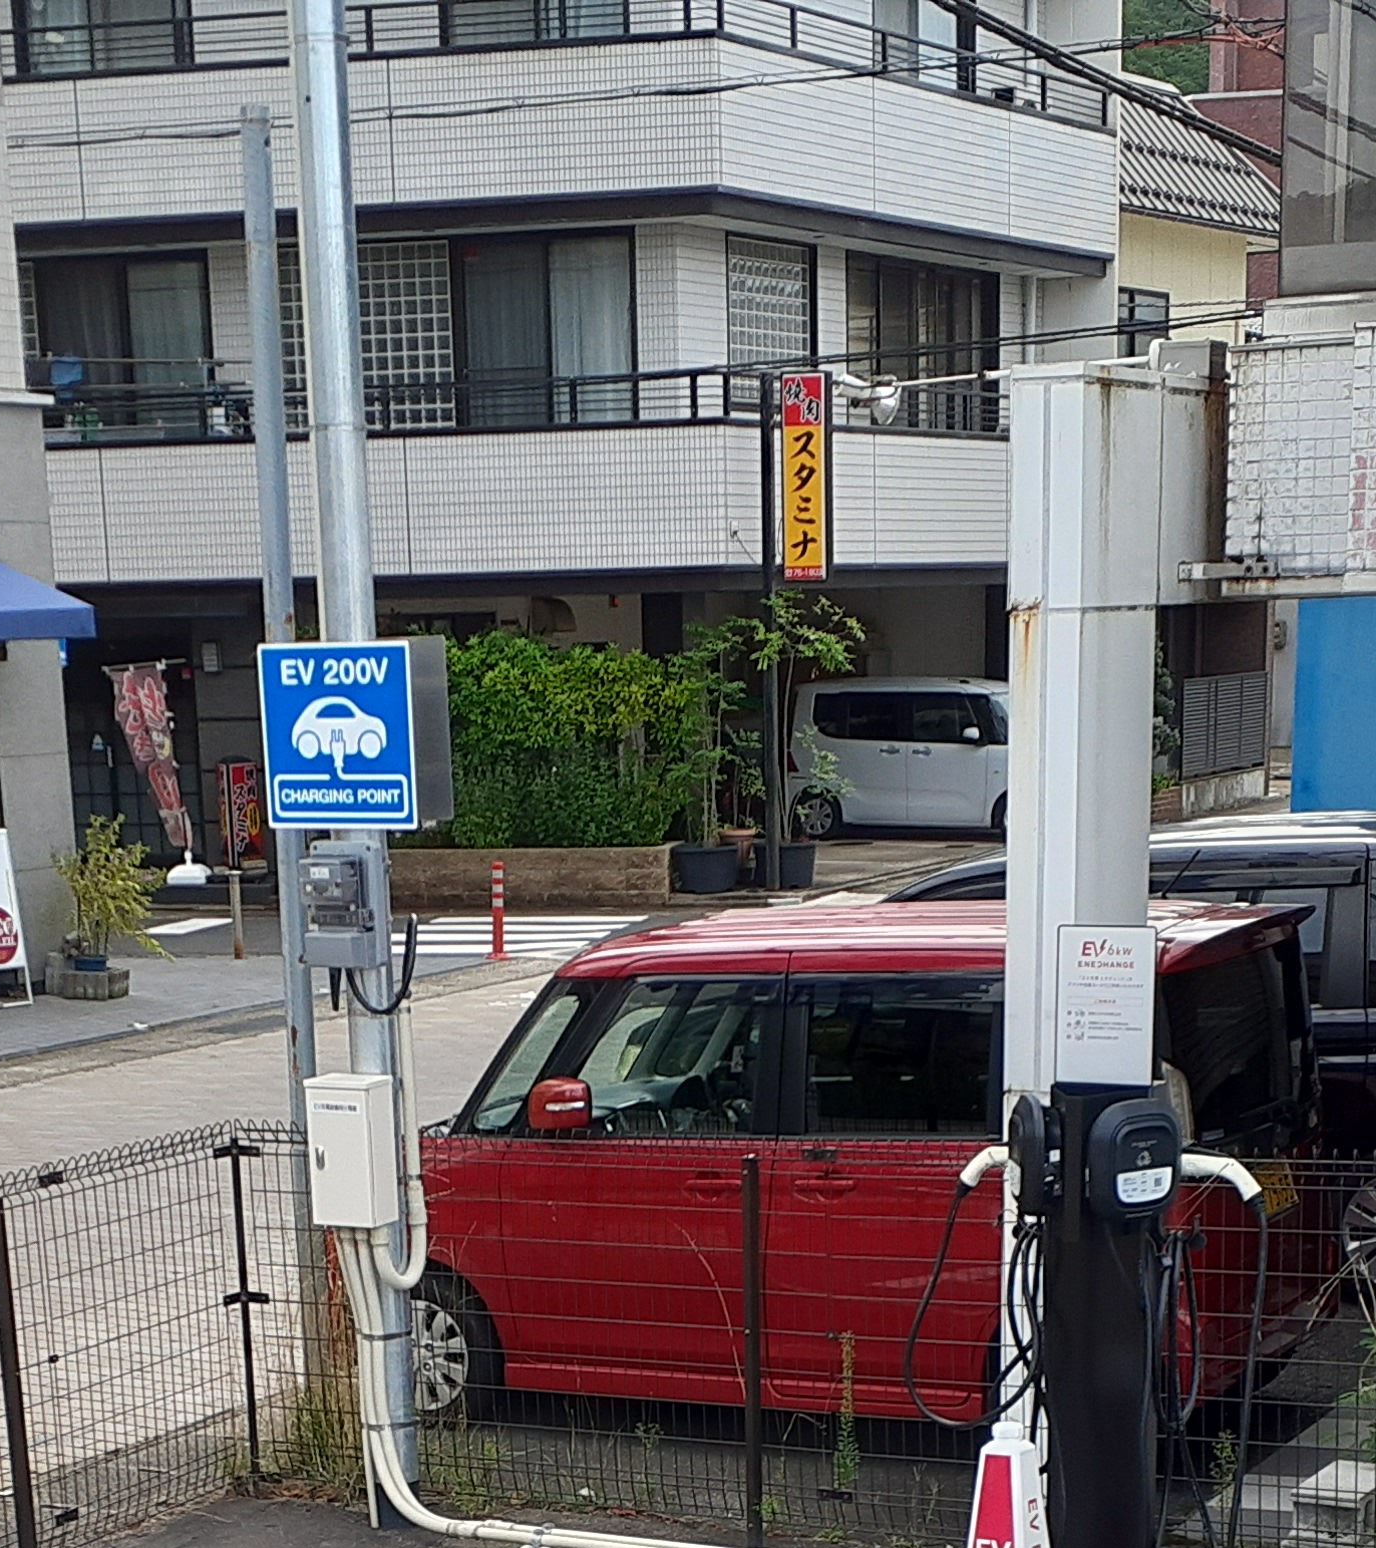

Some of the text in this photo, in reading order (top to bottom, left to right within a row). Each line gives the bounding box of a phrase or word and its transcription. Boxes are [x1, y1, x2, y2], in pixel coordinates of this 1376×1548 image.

[785, 378, 821, 423] 焼肉
[790, 430, 818, 562] スタミナ
[280, 656, 388, 686] EV 200V
[281, 788, 401, 805] CHARGING POINT
[234, 784, 249, 852] スタミナ
[1081, 939, 1108, 957] EV
[1027, 1497, 1040, 1531] EV
